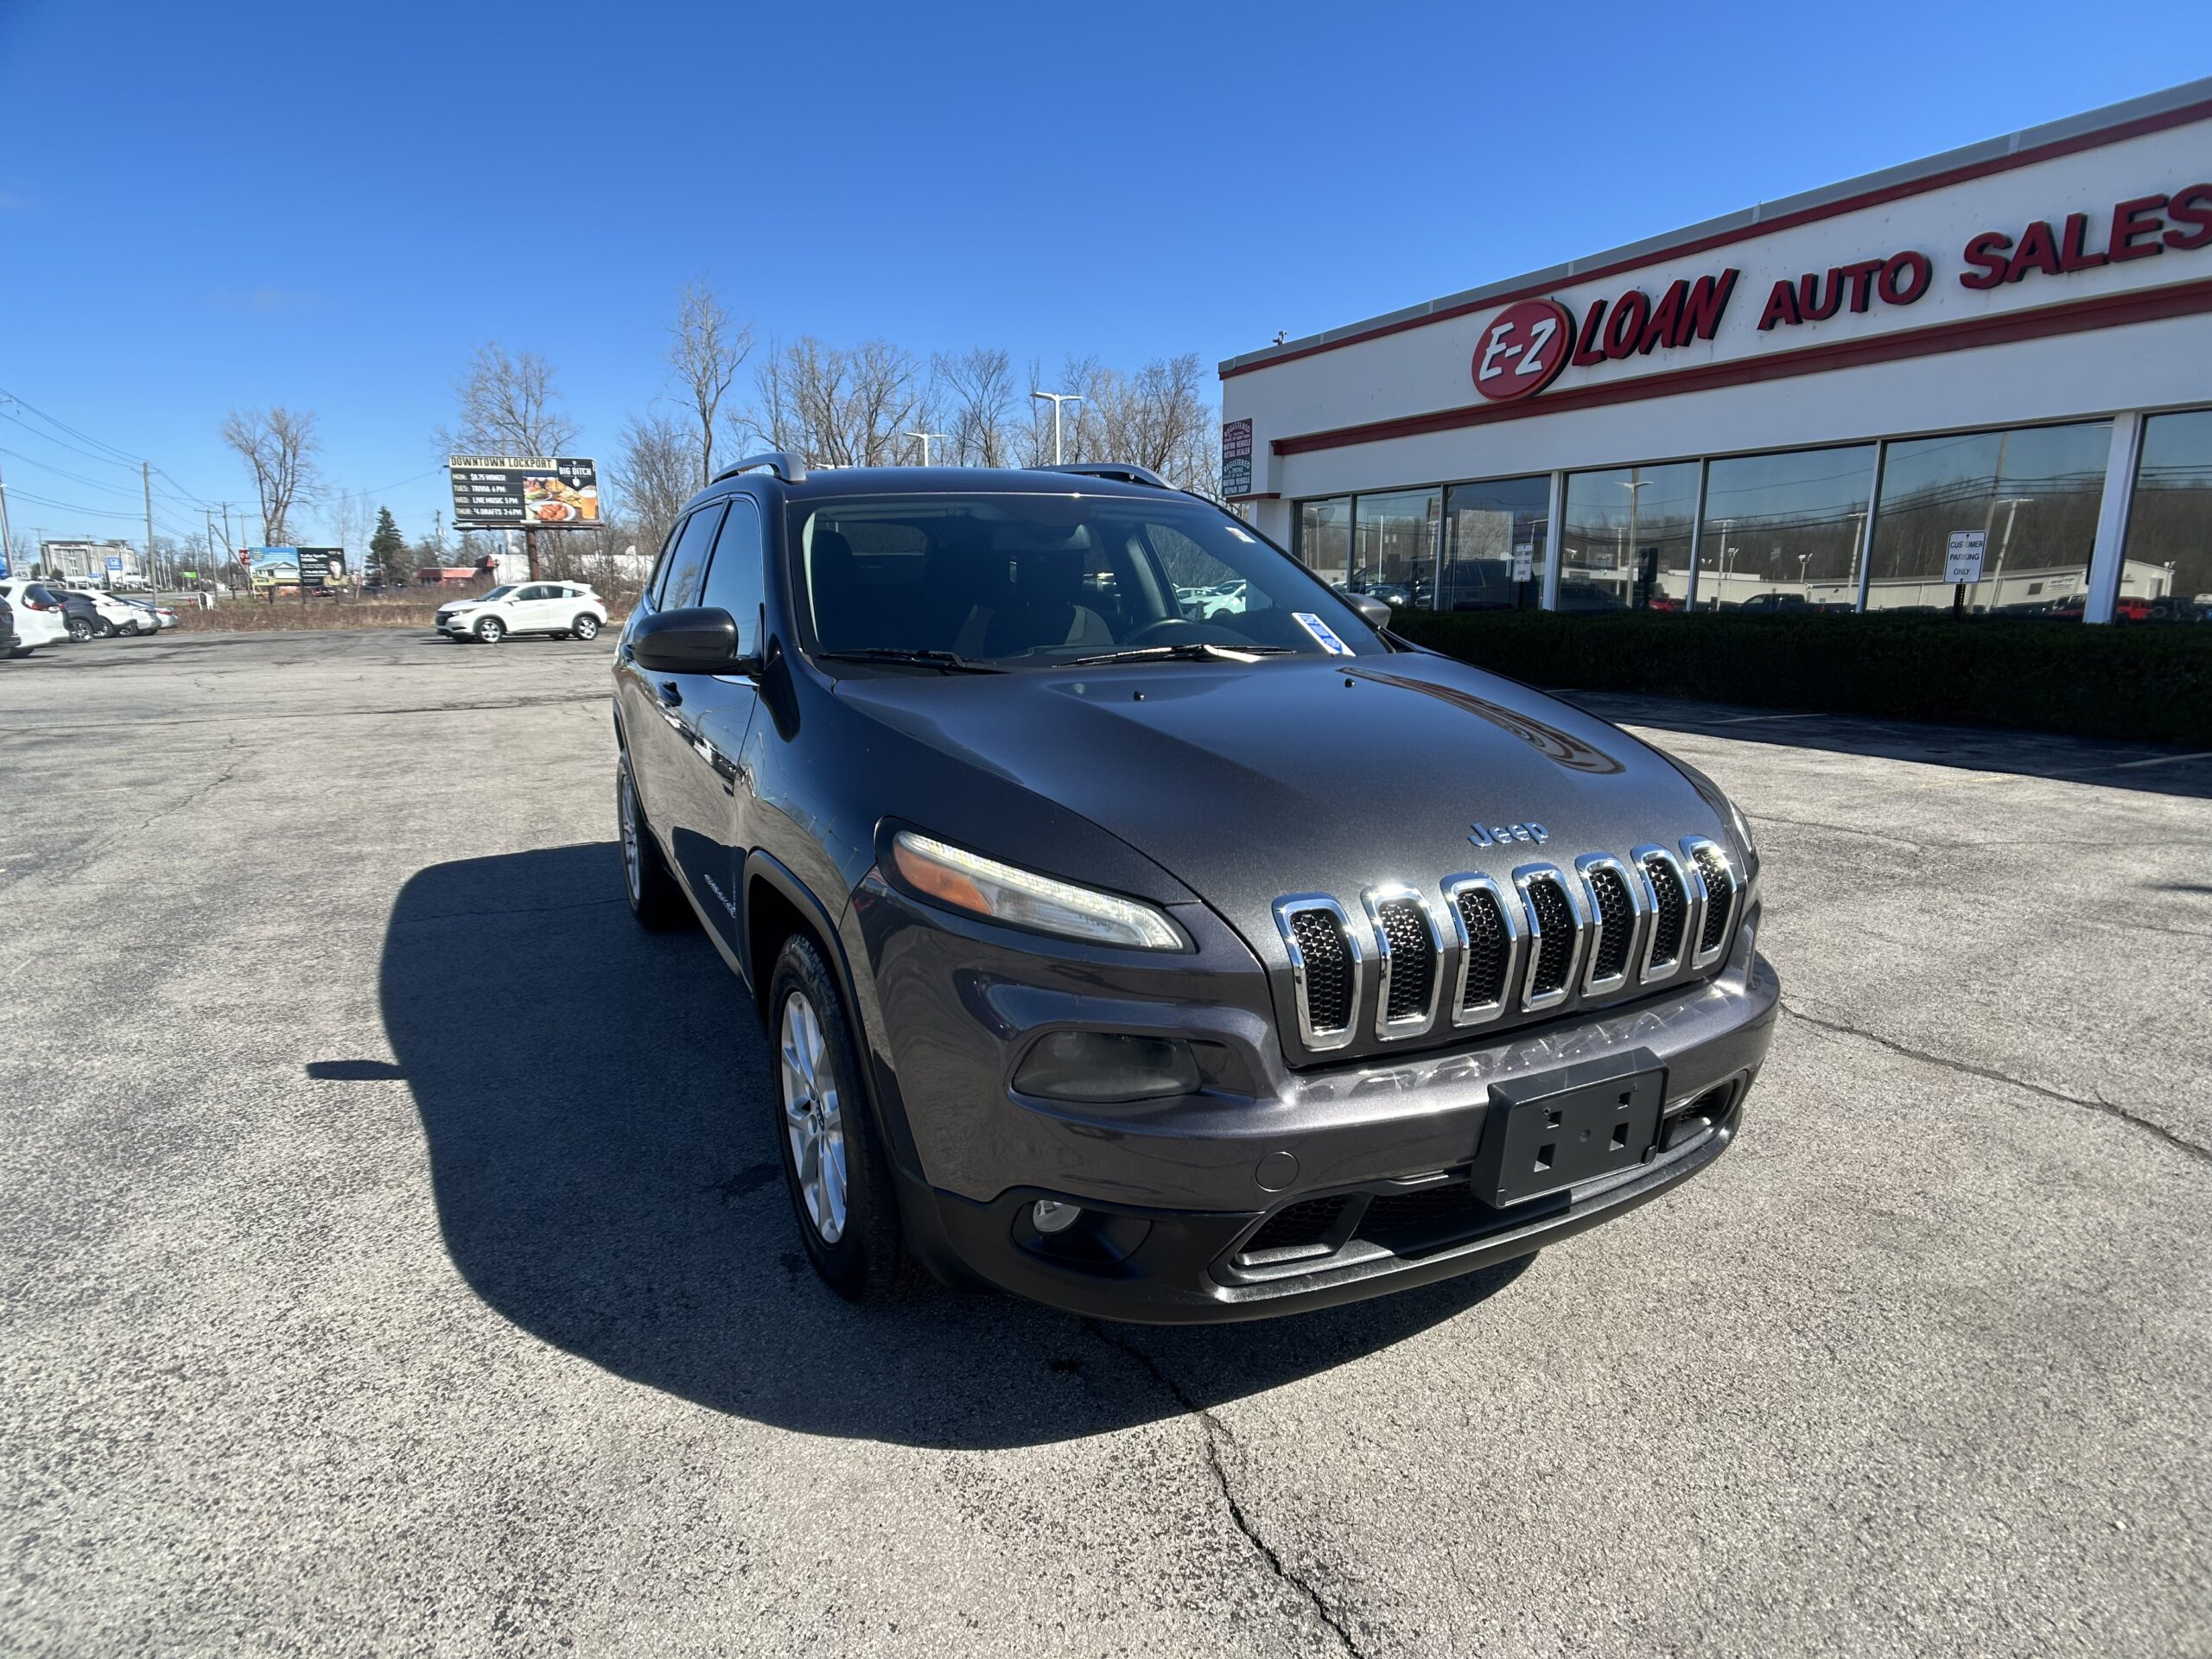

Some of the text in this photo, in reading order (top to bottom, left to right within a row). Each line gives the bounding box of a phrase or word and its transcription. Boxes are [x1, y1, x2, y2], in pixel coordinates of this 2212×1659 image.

[1479, 183, 2212, 381] E-Z LOAN AUTO SALES
[1224, 422, 1251, 438] REGISTERED
[1236, 438, 1251, 448] VEHICLE
[1236, 447, 1250, 456] DEALER
[451, 456, 552, 468] DOWNTOWN LOCKPORT
[1224, 459, 1251, 473] REGISTERED
[558, 467, 592, 475] BIG DITCH
[1236, 476, 1250, 486] VEHICLE
[1238, 485, 1248, 493] SHOP
[1950, 540, 1984, 549] CUSTOMER
[1467, 821, 1549, 848] Jeep
